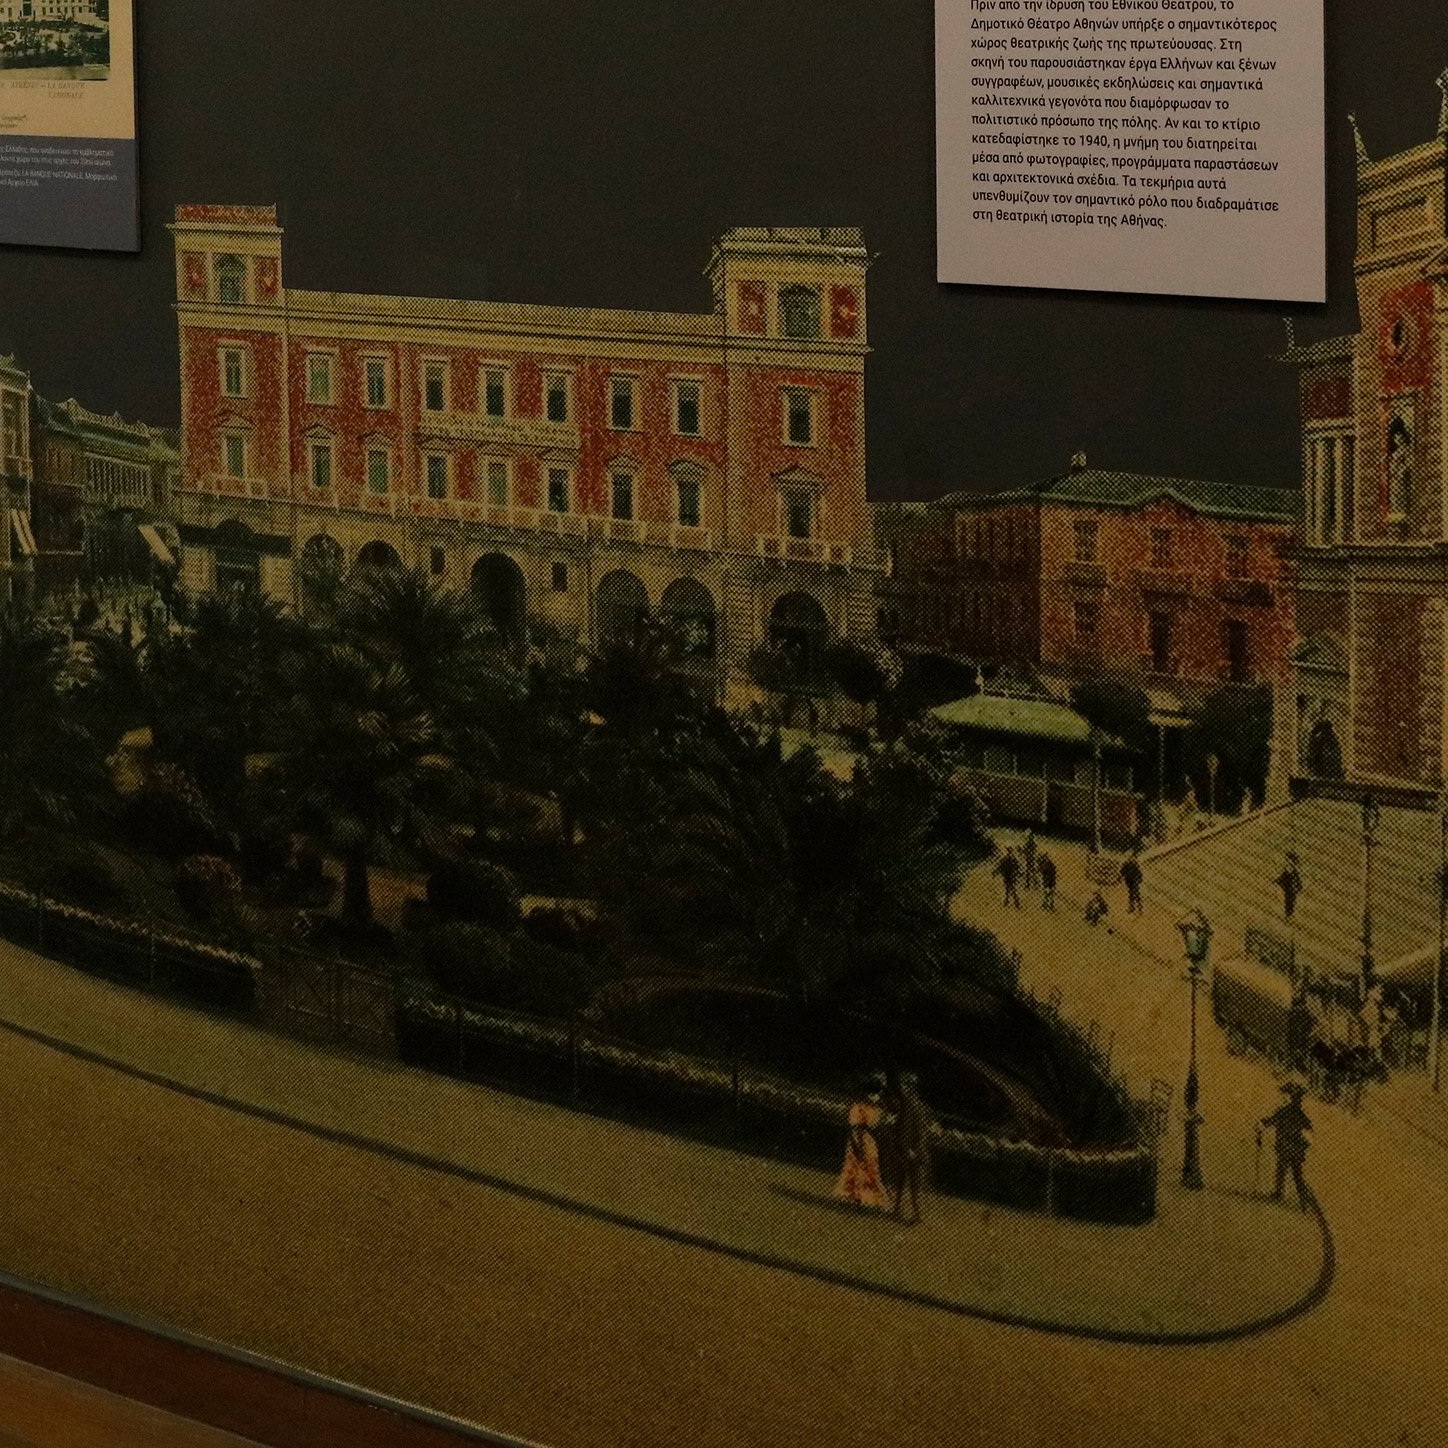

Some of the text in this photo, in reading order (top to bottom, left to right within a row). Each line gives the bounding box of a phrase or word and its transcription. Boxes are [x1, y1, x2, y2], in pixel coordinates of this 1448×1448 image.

[1022, 0, 1043, 13] την
[1087, 0, 1110, 10] του
[1219, 0, 1235, 11] το
[970, 16, 1278, 33] Δημοτικό Θέατρο Αθηνών υπήρξε ο σημαντικότερος
[970, 36, 1243, 53] χώρος θεατρικής ζωής της πρωτεύουσας. Στη
[970, 55, 1277, 73] σκηνή του παρουσιάστηκαν έργα Ελλήνων και ξένων
[971, 131, 1258, 153] κατεδαφίστηκε το 1940, η μνήμη του διατηρείται
